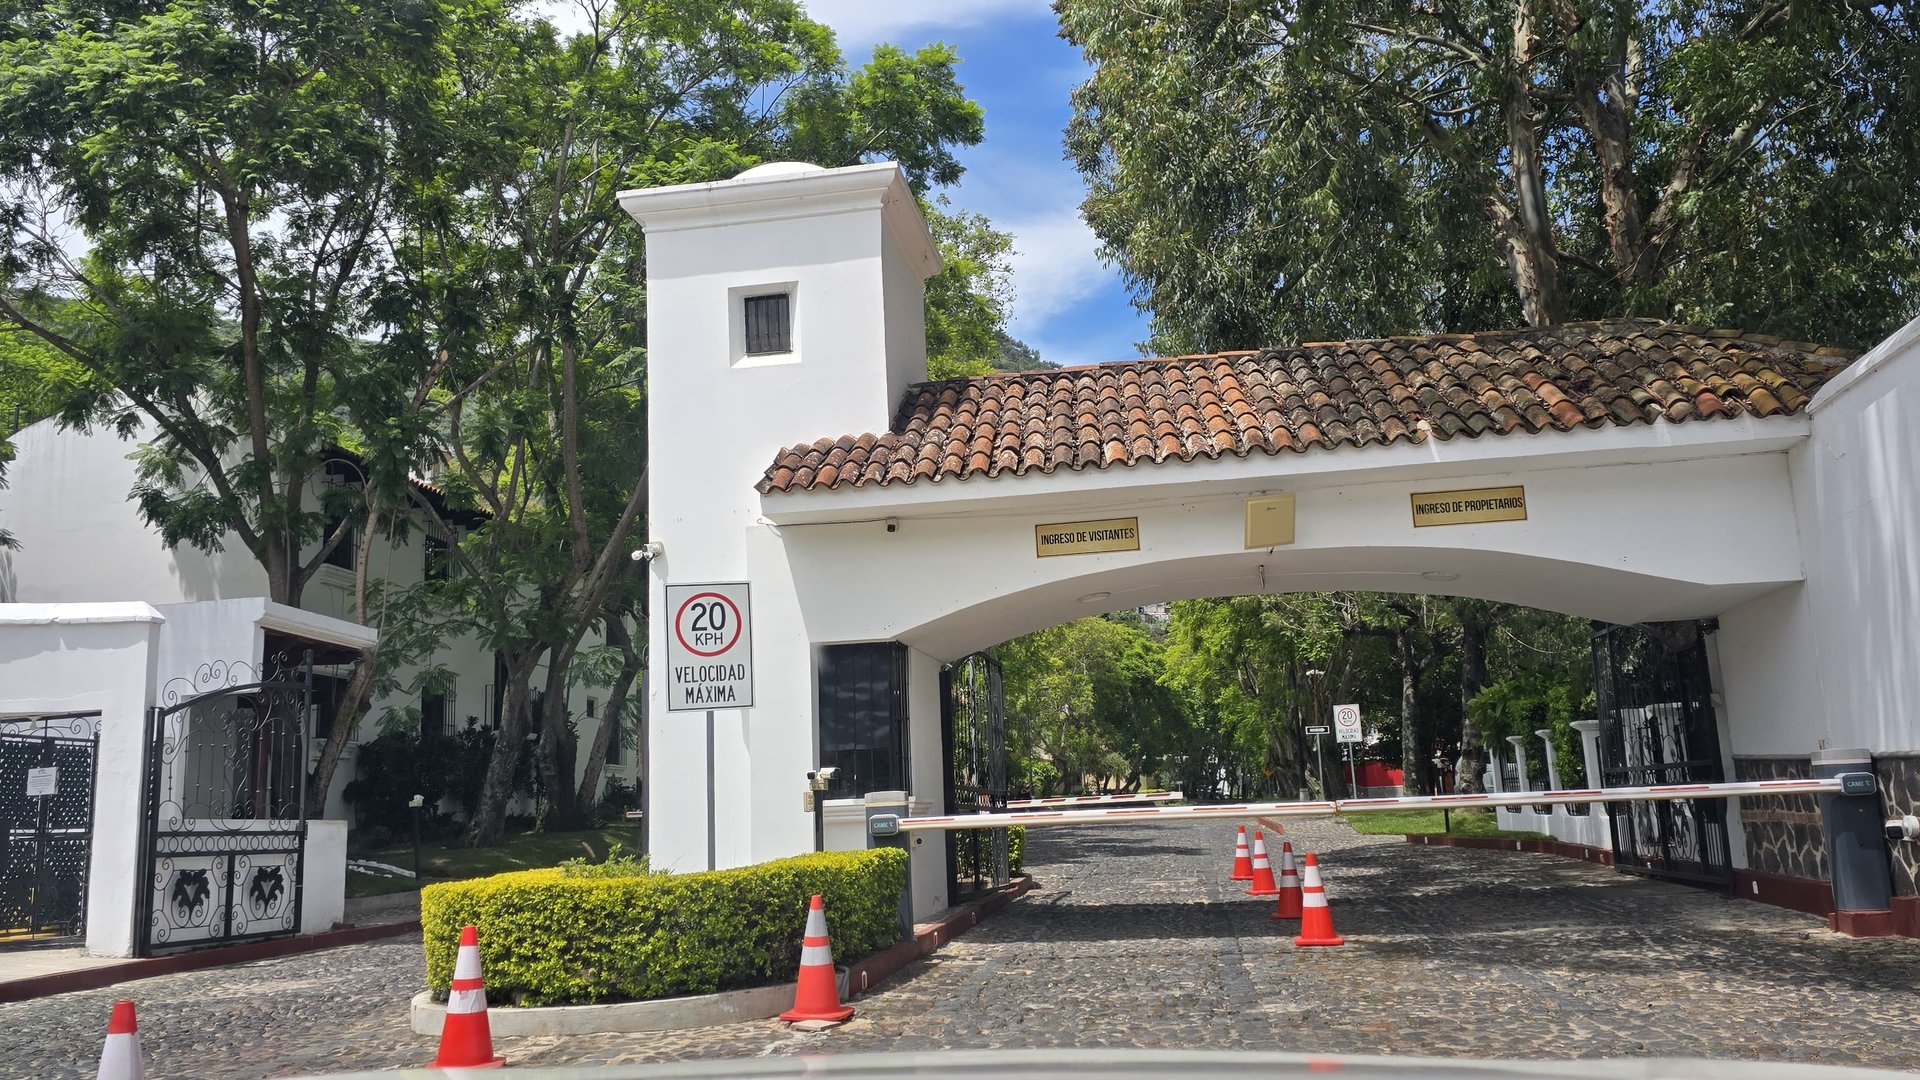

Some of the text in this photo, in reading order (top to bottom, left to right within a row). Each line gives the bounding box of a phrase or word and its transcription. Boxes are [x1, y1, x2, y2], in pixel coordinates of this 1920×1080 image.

[1416, 497, 1523, 515] INGRESO DE PROPIETARIOS
[1041, 527, 1135, 546] INGRESO DE VISITANTES
[690, 601, 726, 632] 20
[695, 632, 724, 646] KPH
[675, 664, 745, 683] VELOCIDAD
[685, 683, 736, 704] MÁXIMA
[1342, 710, 1353, 720] 20
